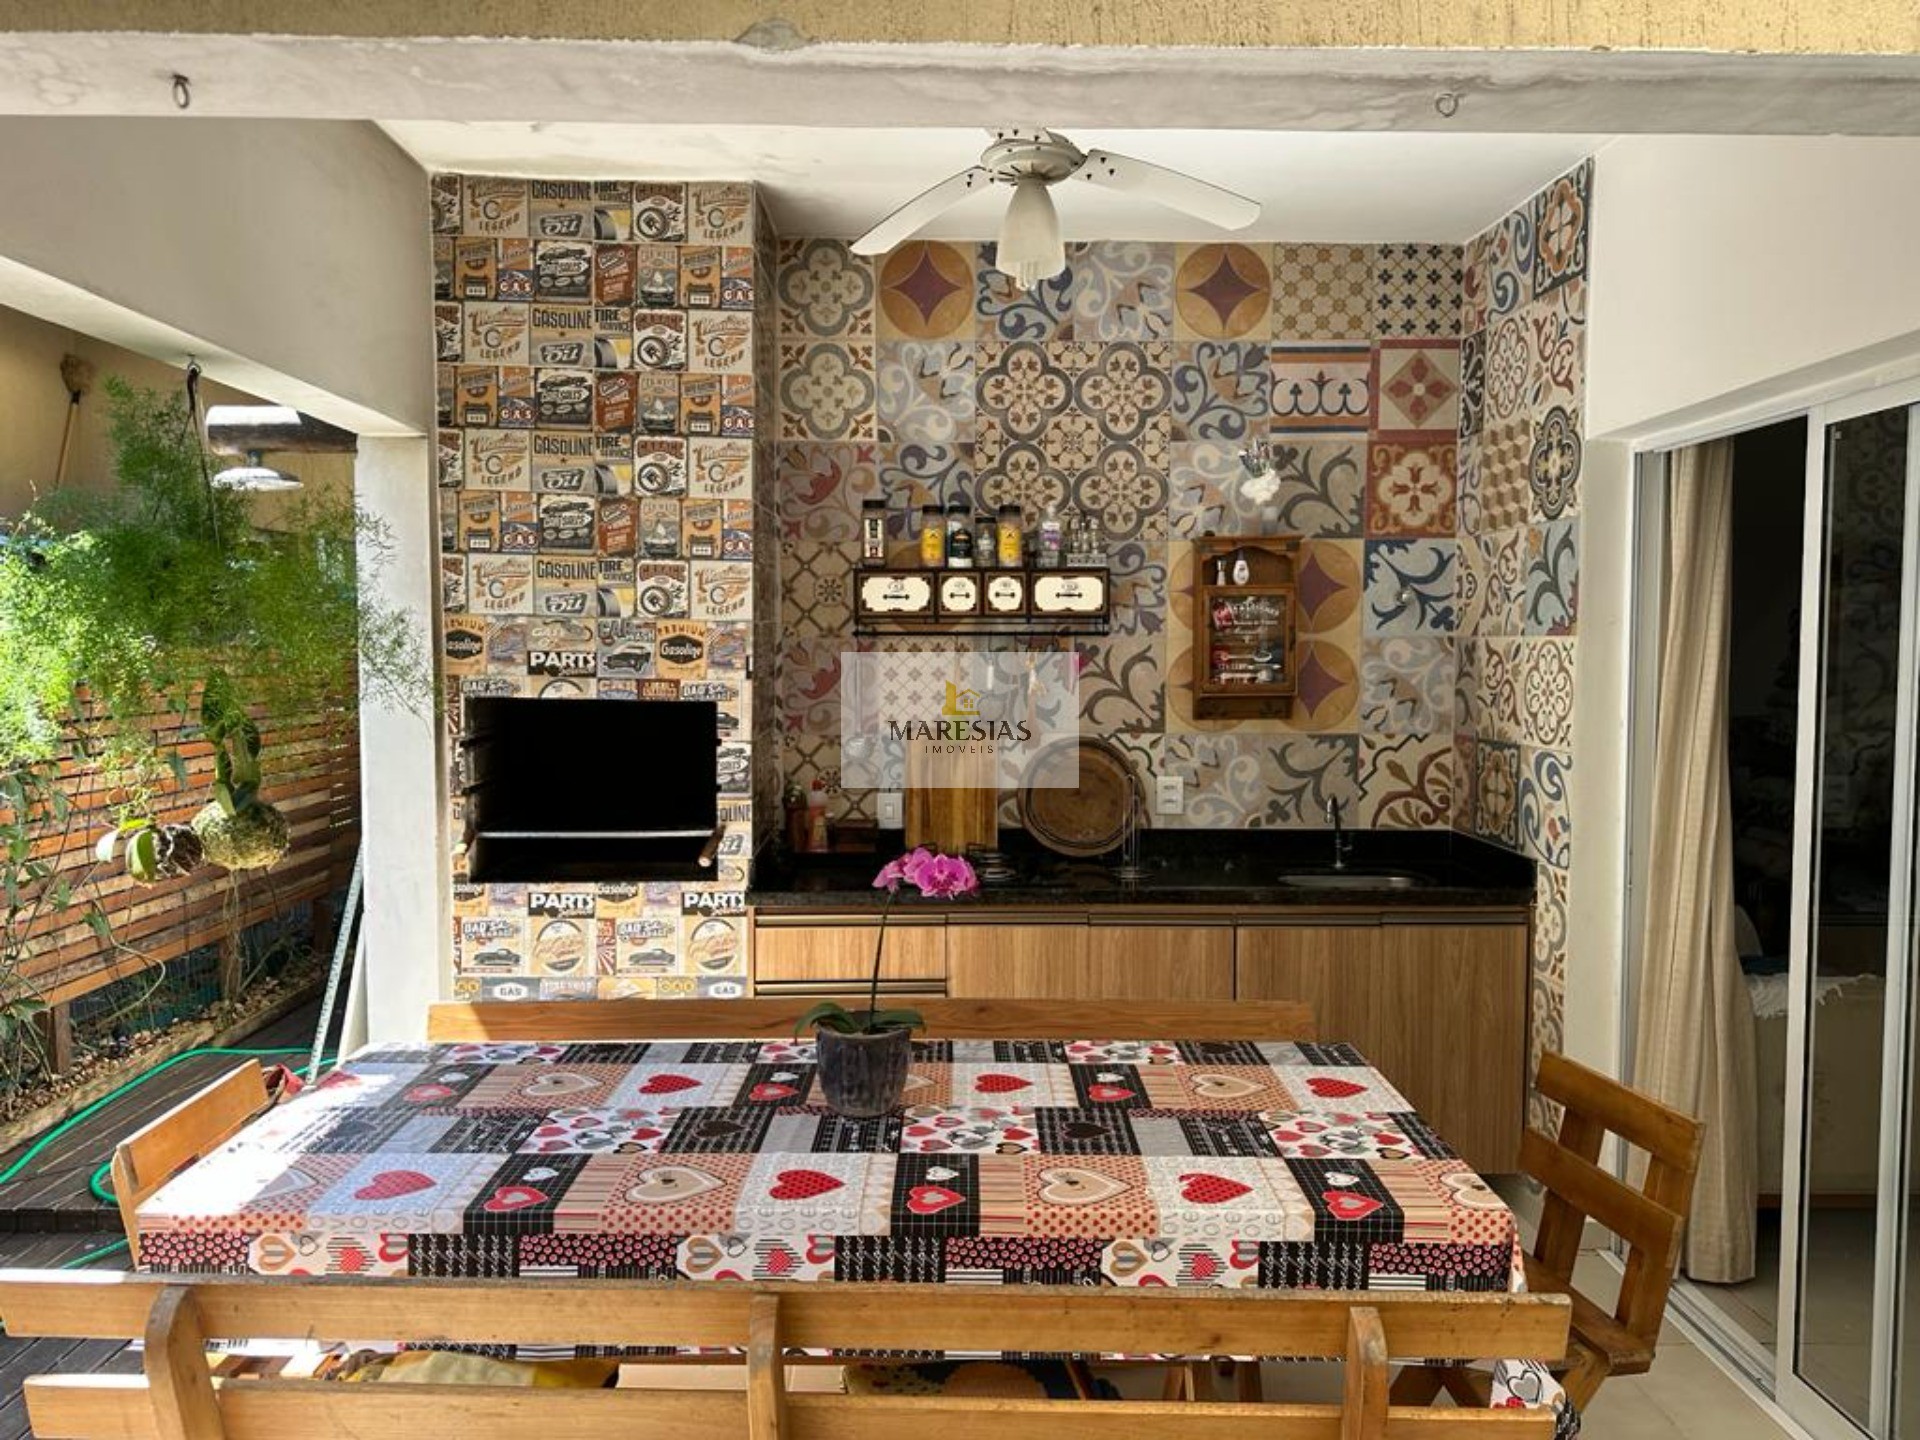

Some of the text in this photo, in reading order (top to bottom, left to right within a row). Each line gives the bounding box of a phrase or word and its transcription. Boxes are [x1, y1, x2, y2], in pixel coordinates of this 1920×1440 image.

[532, 307, 592, 330] GASOLINE
[534, 434, 593, 457] GASOLINE
[537, 560, 596, 581] GASOLINE
[530, 651, 596, 667] PARTS
[500, 987, 522, 997] GAS
